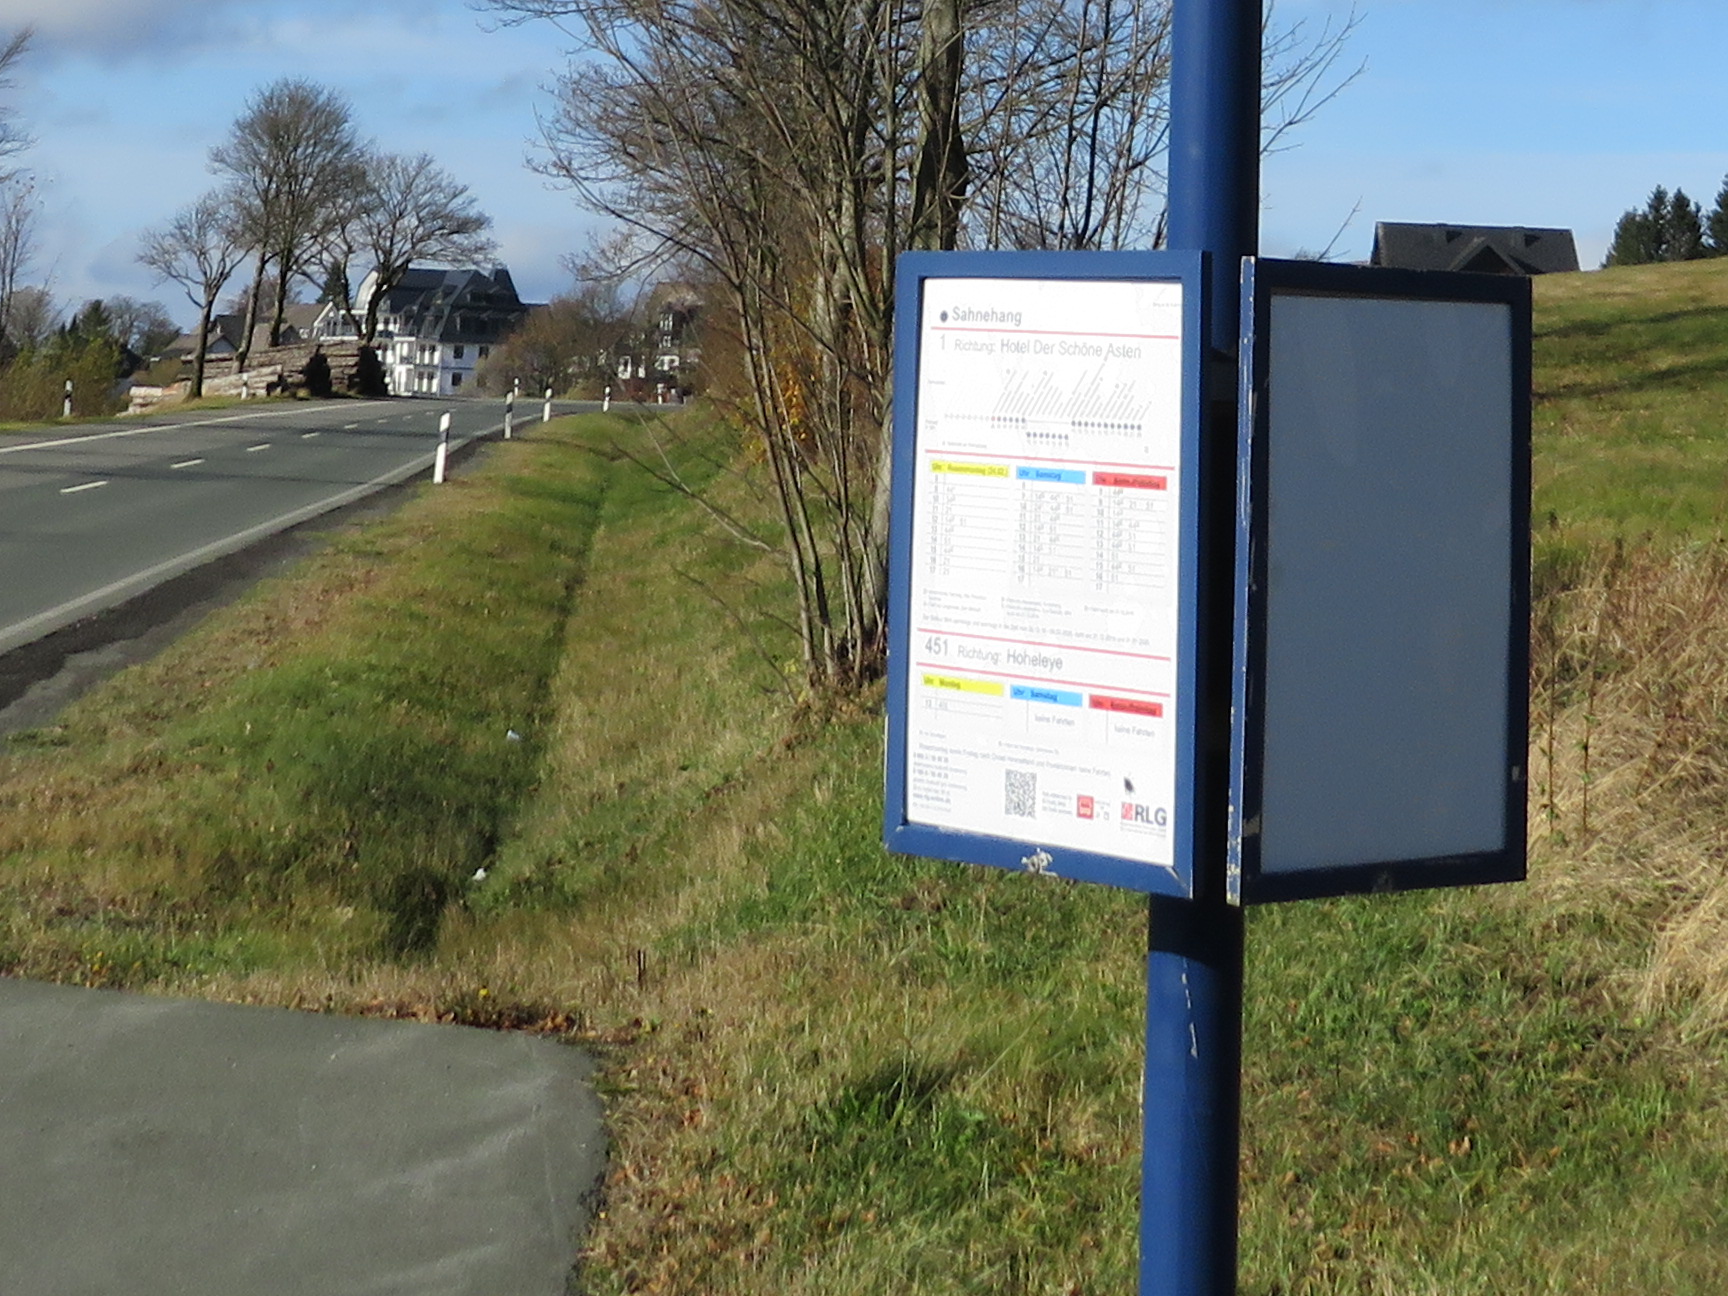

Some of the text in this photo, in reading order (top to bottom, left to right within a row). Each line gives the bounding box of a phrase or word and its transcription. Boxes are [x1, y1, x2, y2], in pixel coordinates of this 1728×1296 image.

[952, 306, 1022, 326] Sahnehang
[954, 338, 1142, 359] Richtung: Hotel Der Schöne Asten
[925, 636, 949, 656] 451
[957, 645, 1063, 670] Richtung: Hoheleye
[1135, 803, 1167, 826] RLG
